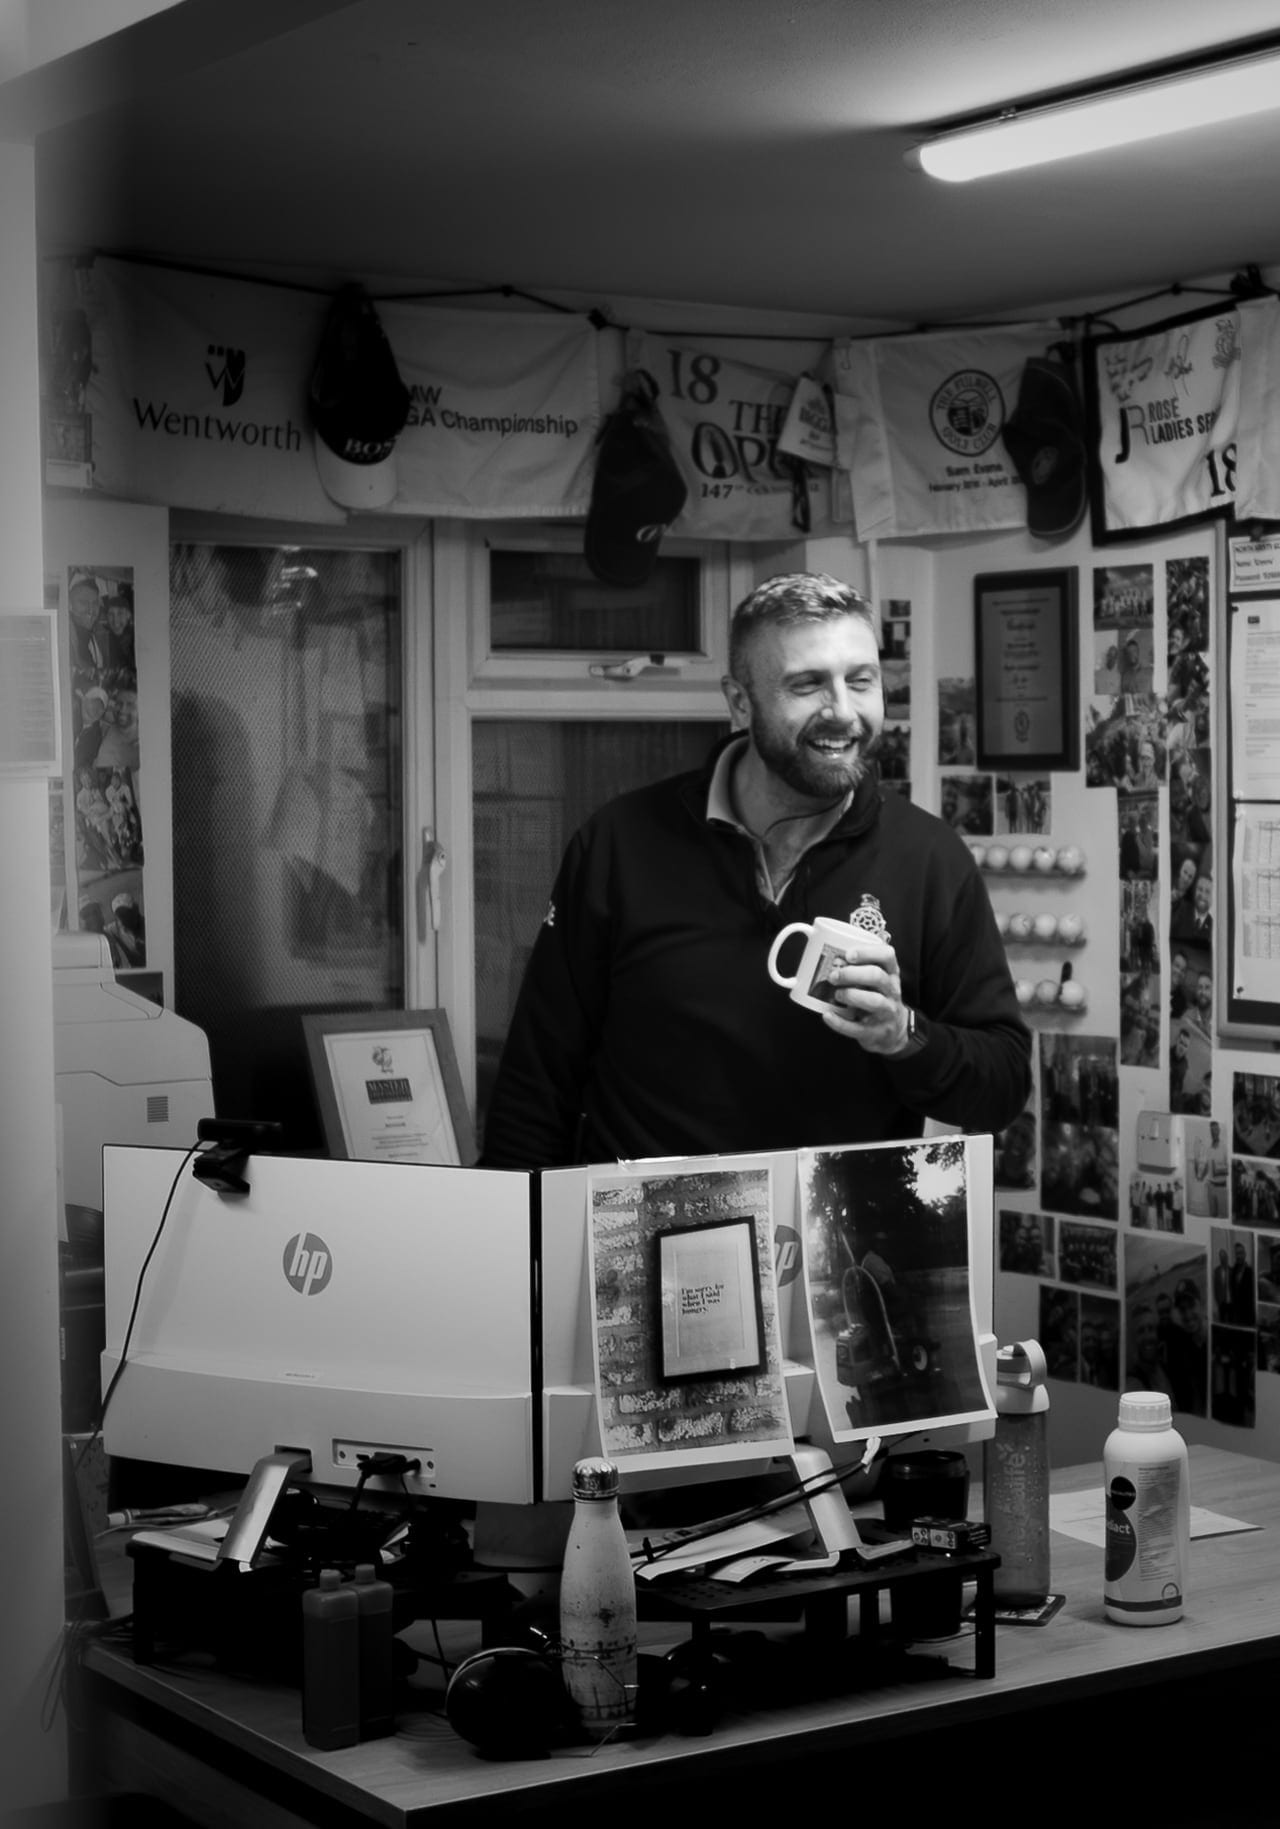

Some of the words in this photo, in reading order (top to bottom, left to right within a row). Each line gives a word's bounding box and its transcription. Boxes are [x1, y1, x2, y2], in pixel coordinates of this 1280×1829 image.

[409, 385, 442, 405] MW
[667, 348, 721, 405] 18
[132, 396, 301, 452] Wentworth
[404, 406, 436, 428] GA
[441, 408, 579, 438] Championship
[1148, 398, 1179, 424] ROSE
[1151, 416, 1195, 445] LADIES
[1206, 442, 1237, 497] 18
[288, 1233, 329, 1297] hp
